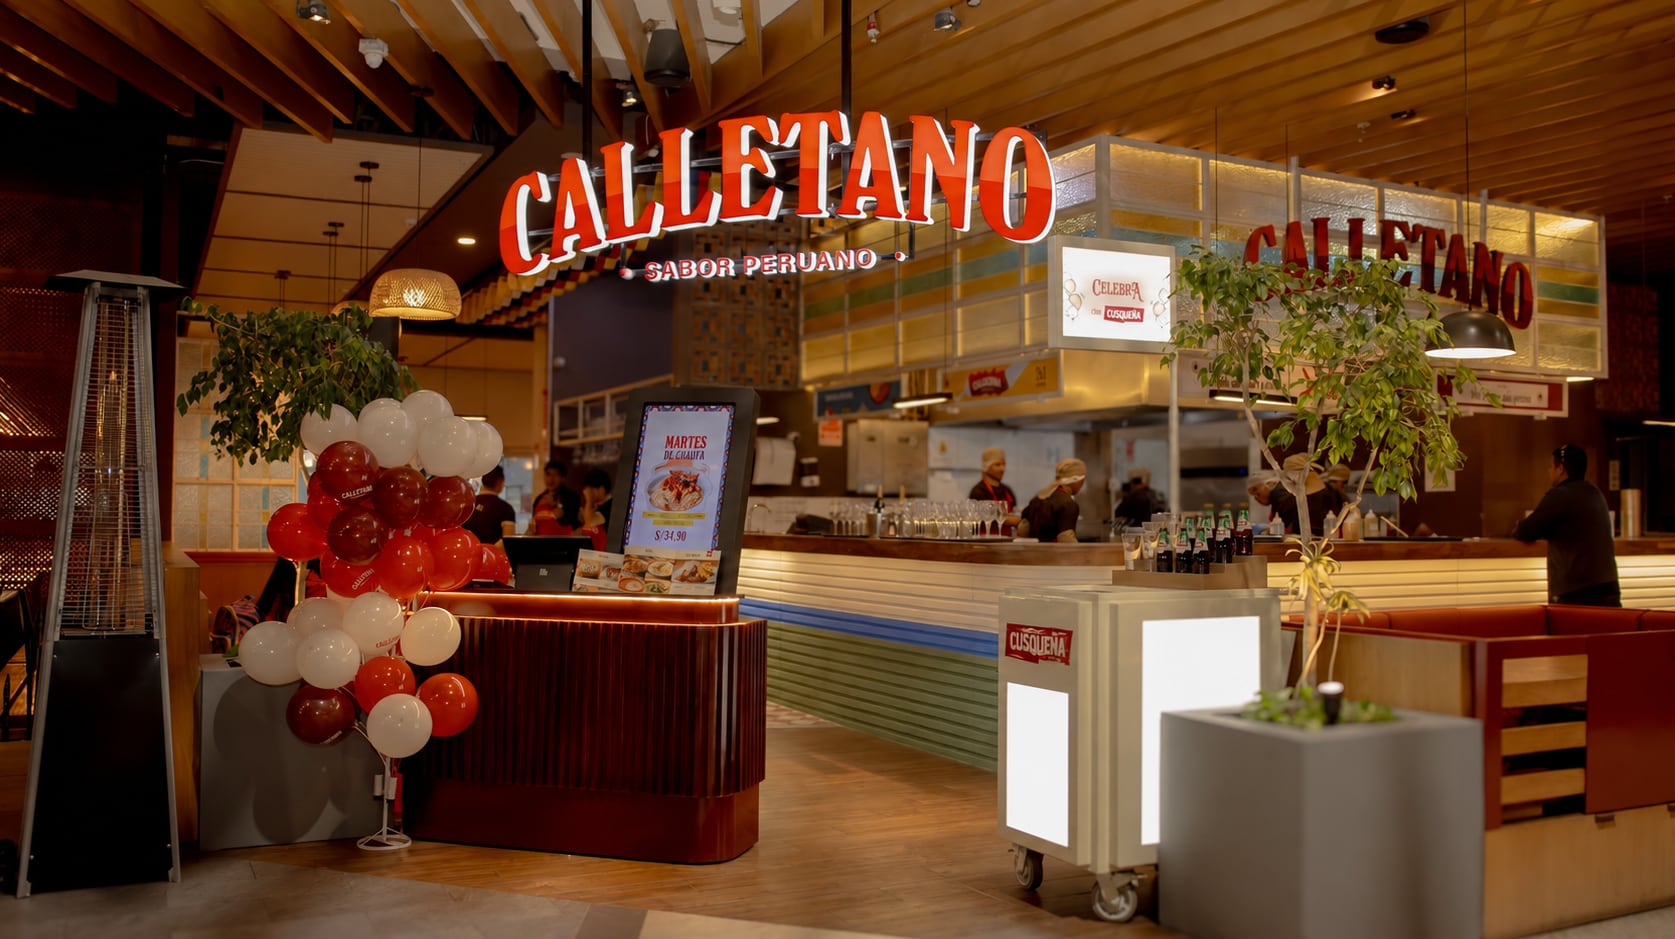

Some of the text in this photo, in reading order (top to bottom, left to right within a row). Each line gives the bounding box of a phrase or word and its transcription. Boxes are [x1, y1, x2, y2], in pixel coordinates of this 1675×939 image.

[498, 109, 1057, 276] CALLETANO
[644, 248, 878, 283] SABOR PERUANO
[664, 435, 708, 449] MARTES
[1009, 631, 1067, 658] CUSQUEÑA
